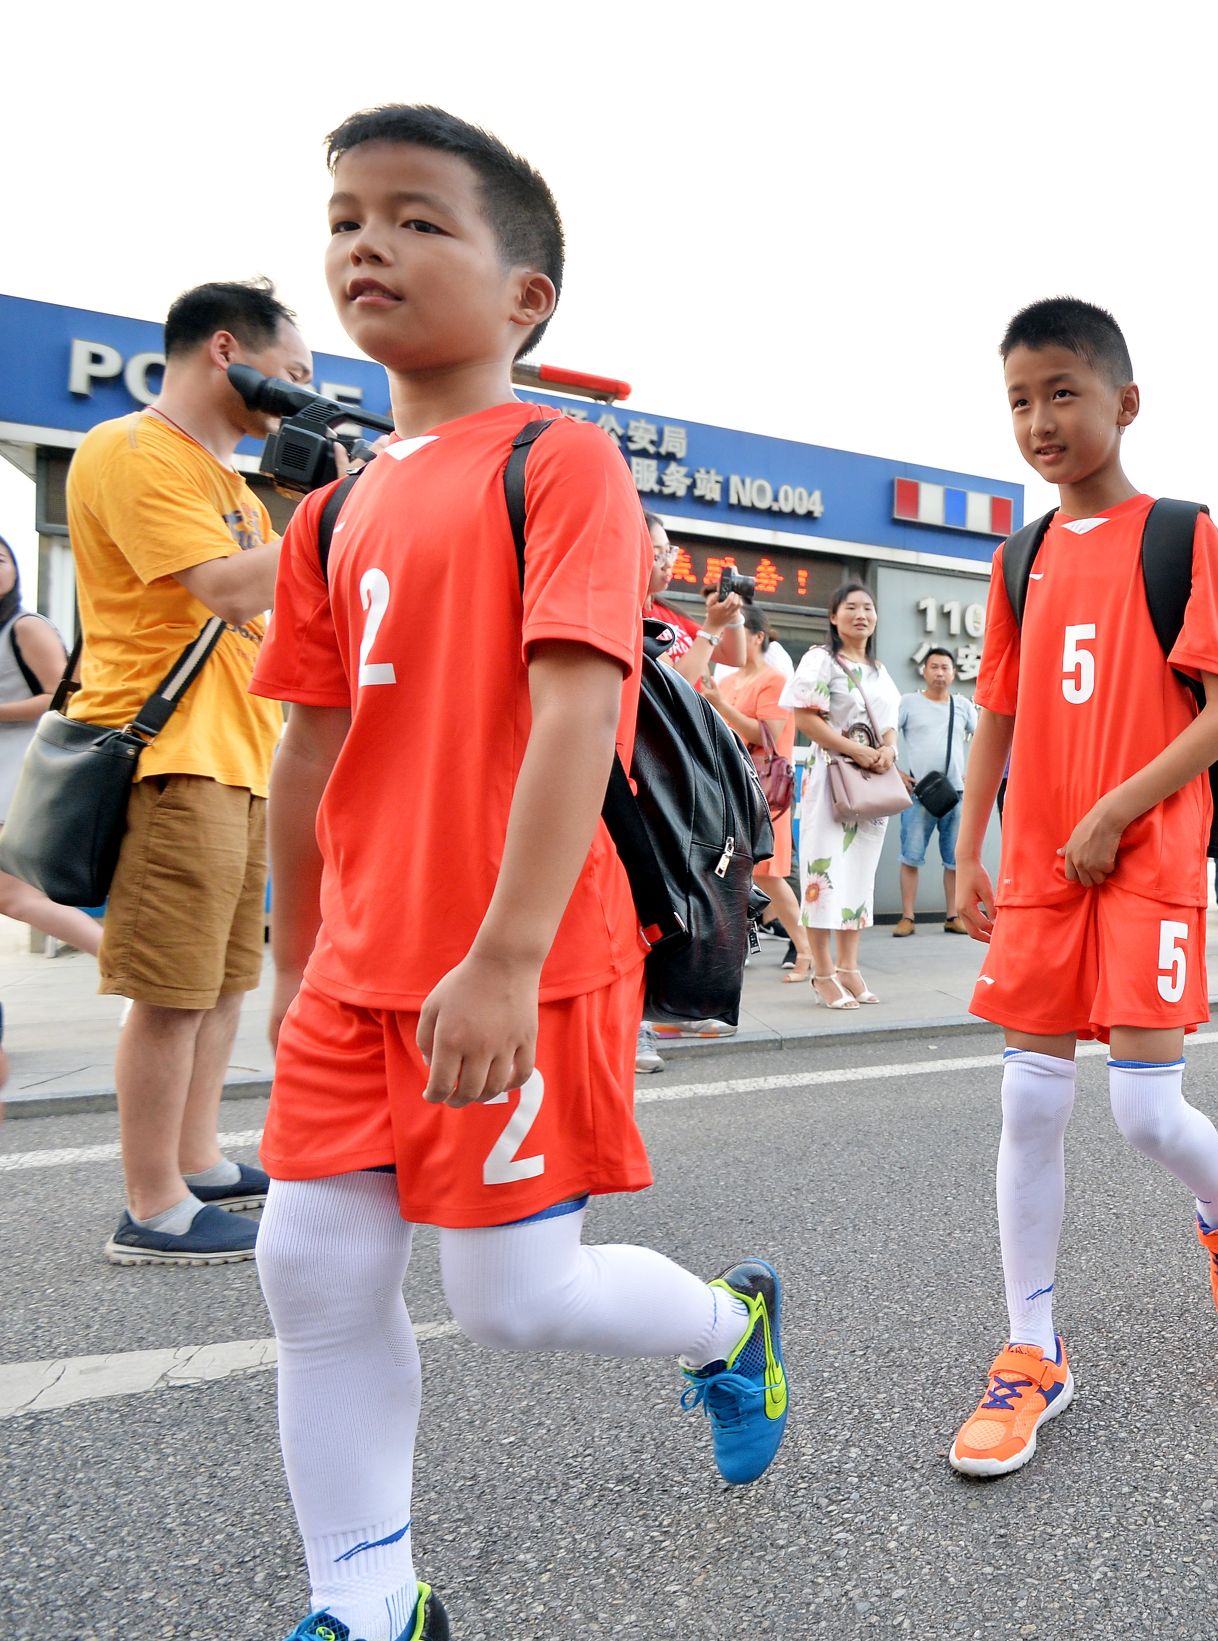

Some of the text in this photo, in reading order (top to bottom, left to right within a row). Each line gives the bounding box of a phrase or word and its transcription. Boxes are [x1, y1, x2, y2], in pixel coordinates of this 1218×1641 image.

[68, 338, 362, 437] POE
[631, 456, 824, 518] 服务站 NO.004
[359, 567, 397, 687] 2
[919, 597, 985, 638] 110
[1061, 623, 1097, 704] 5
[1157, 919, 1189, 1003] 5
[482, 1067, 546, 1186] 2
